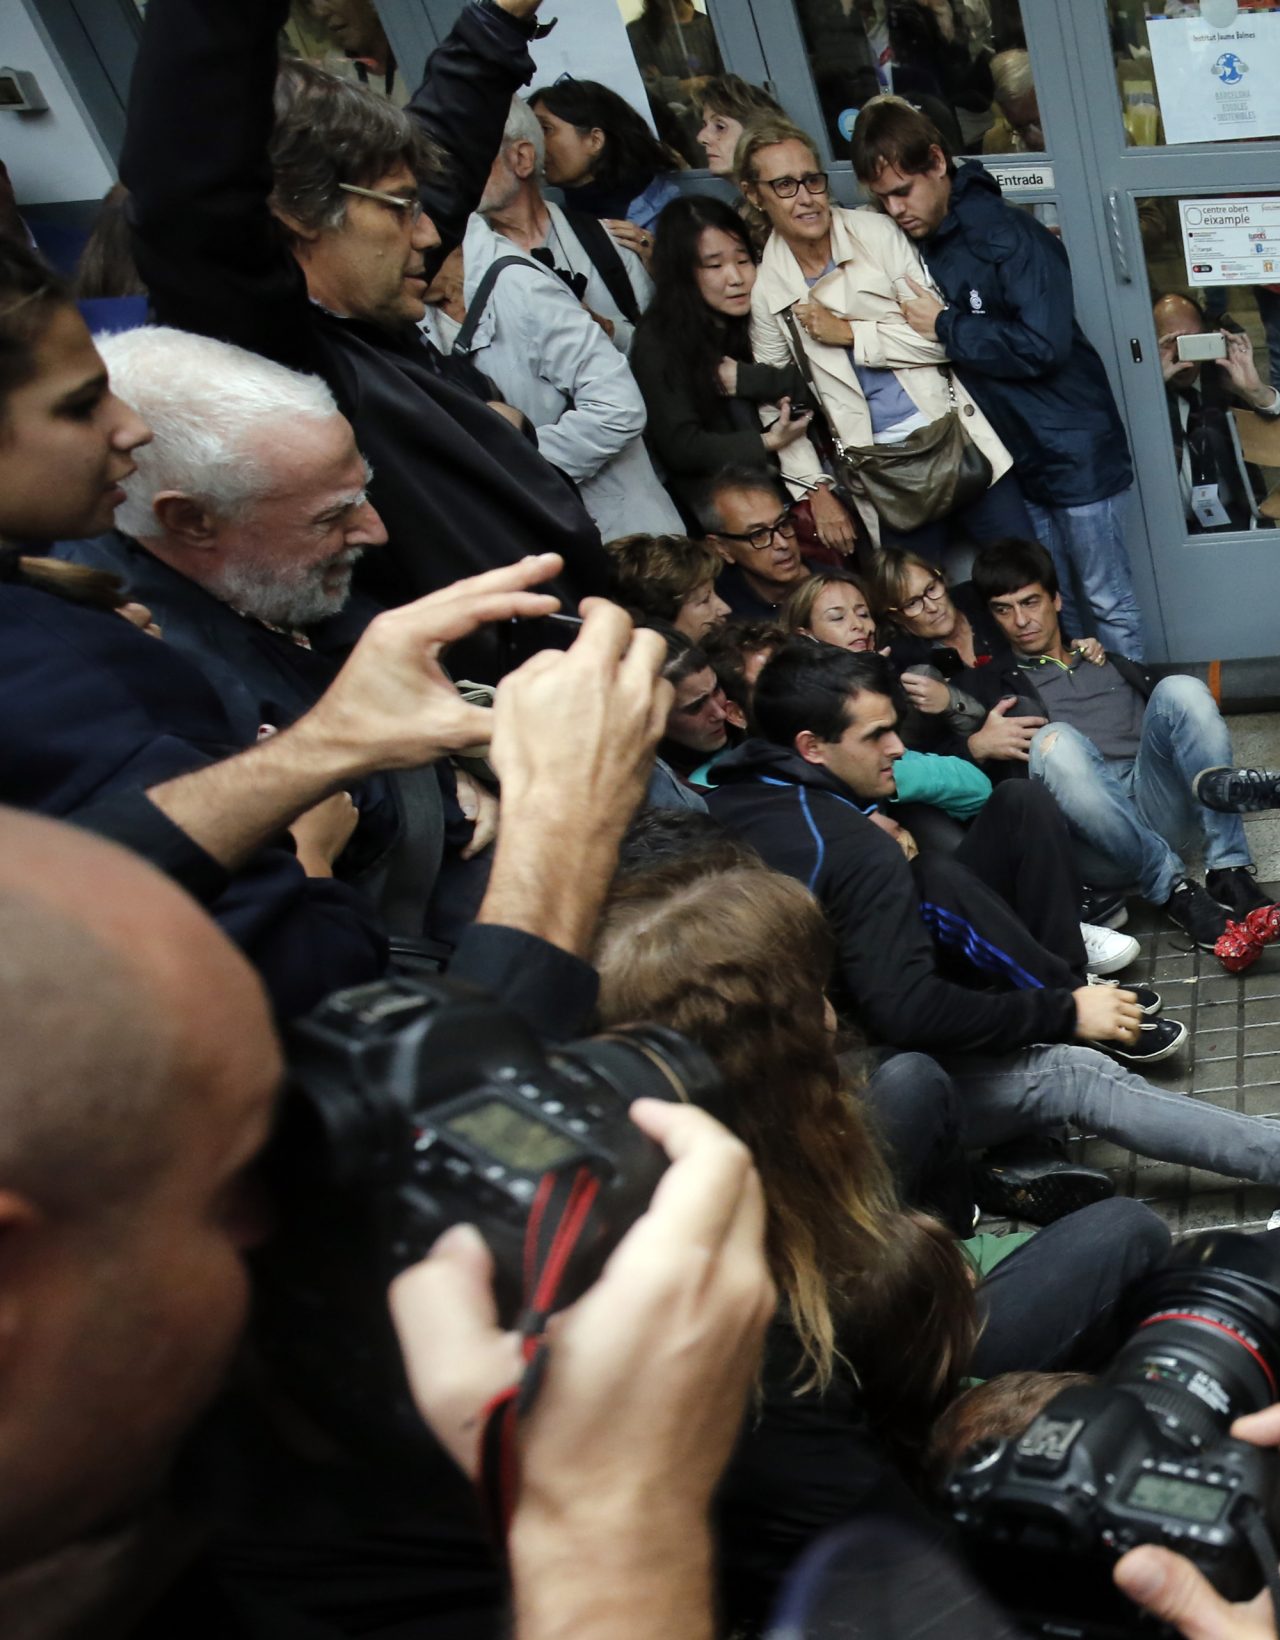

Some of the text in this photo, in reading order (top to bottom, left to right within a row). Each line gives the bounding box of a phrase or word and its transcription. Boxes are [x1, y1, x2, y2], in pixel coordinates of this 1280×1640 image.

[1217, 32, 1235, 42] Jaume
[996, 173, 1043, 186] Entrada
[1203, 205, 1249, 214] centre obert
[1204, 214, 1250, 226] eixample
